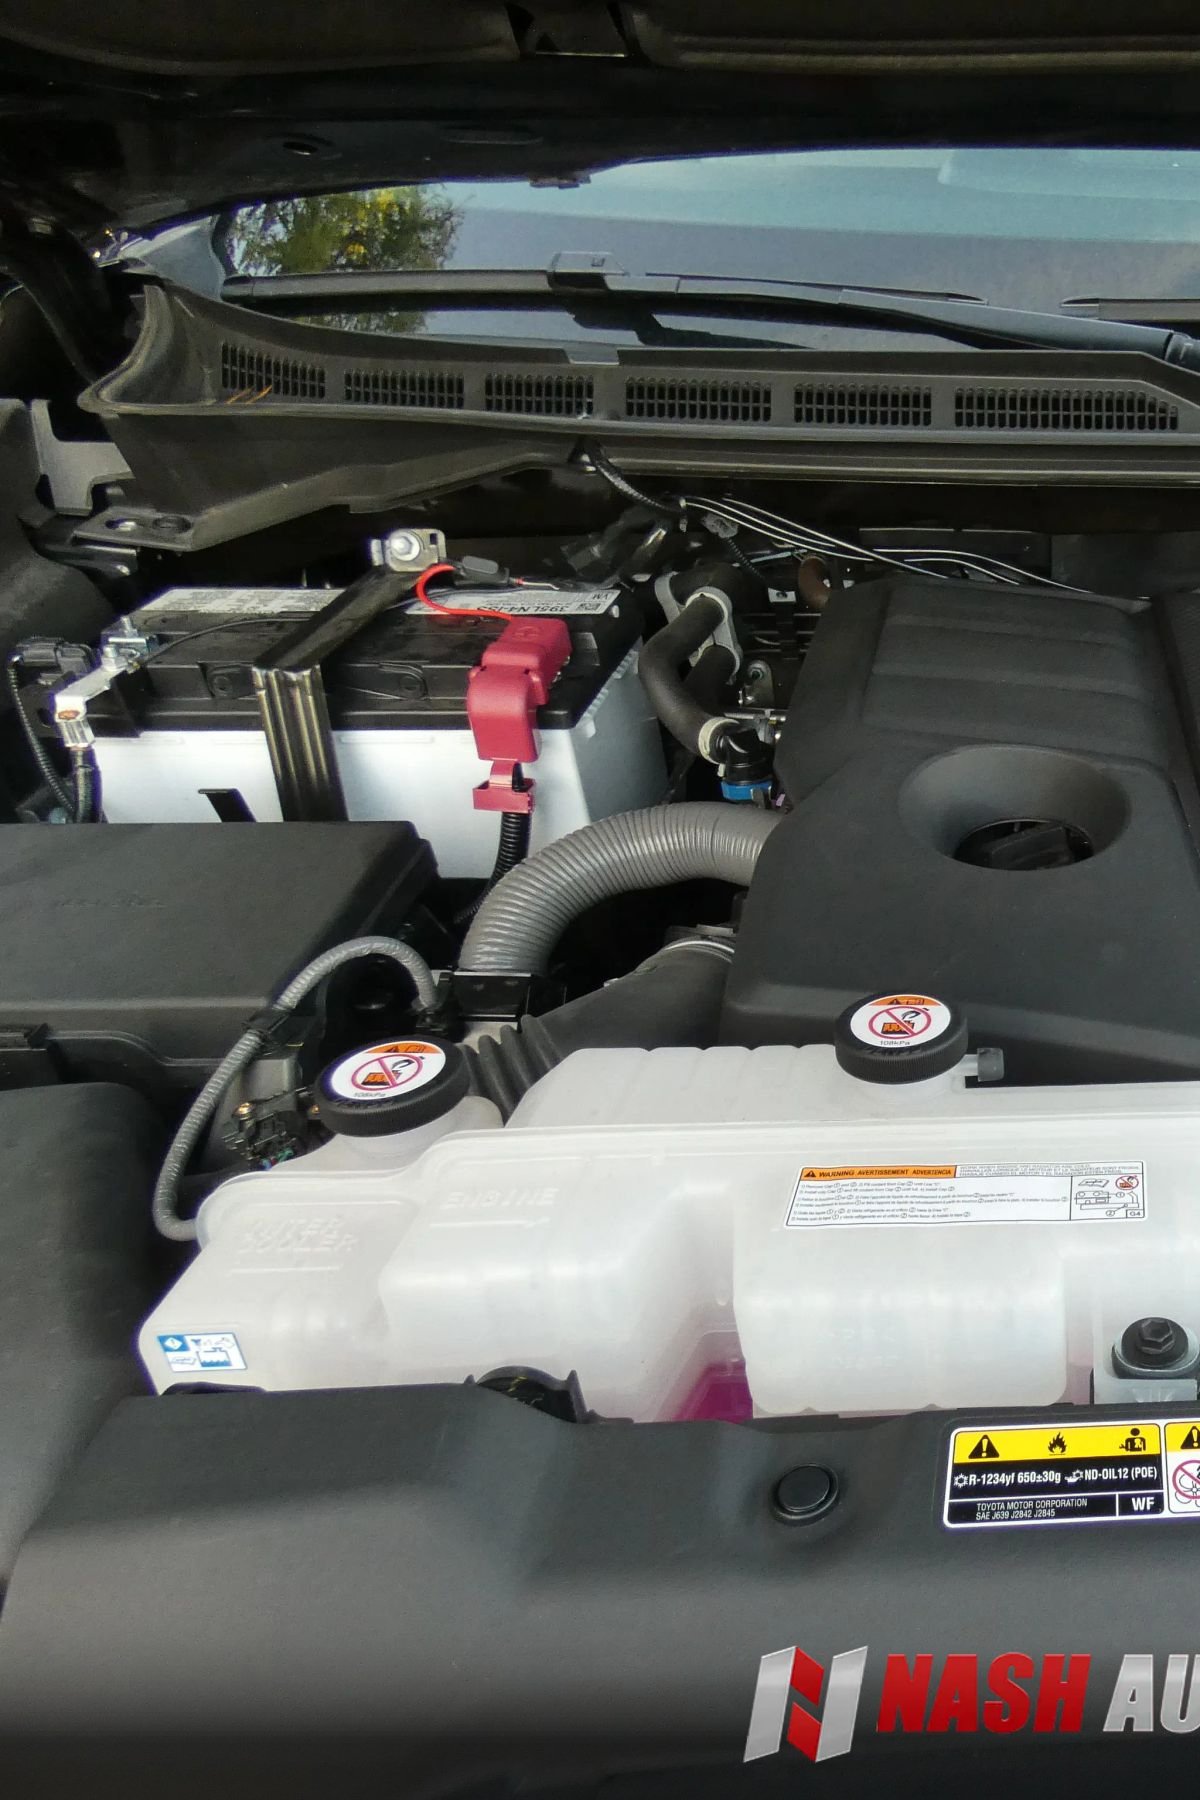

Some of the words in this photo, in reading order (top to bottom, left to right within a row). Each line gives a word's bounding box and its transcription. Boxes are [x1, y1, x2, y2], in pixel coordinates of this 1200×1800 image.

[819, 1170, 854, 1178] WARNING
[969, 1473, 1015, 1486] R-1234yf
[1017, 1470, 1061, 1483] 650±30g
[1085, 1468, 1128, 1480] ND-OIL12
[1131, 1467, 1157, 1480] (POE)
[977, 1502, 1005, 1511] TOYOTA
[1007, 1501, 1033, 1509] MOTOR
[1036, 1499, 1087, 1508] CORPORATION
[1131, 1497, 1154, 1511] WF
[976, 1511, 990, 1520] SAE
[992, 1511, 1009, 1519] J639
[1011, 1510, 1032, 1518] J2842
[1034, 1509, 1055, 1517] J2845
